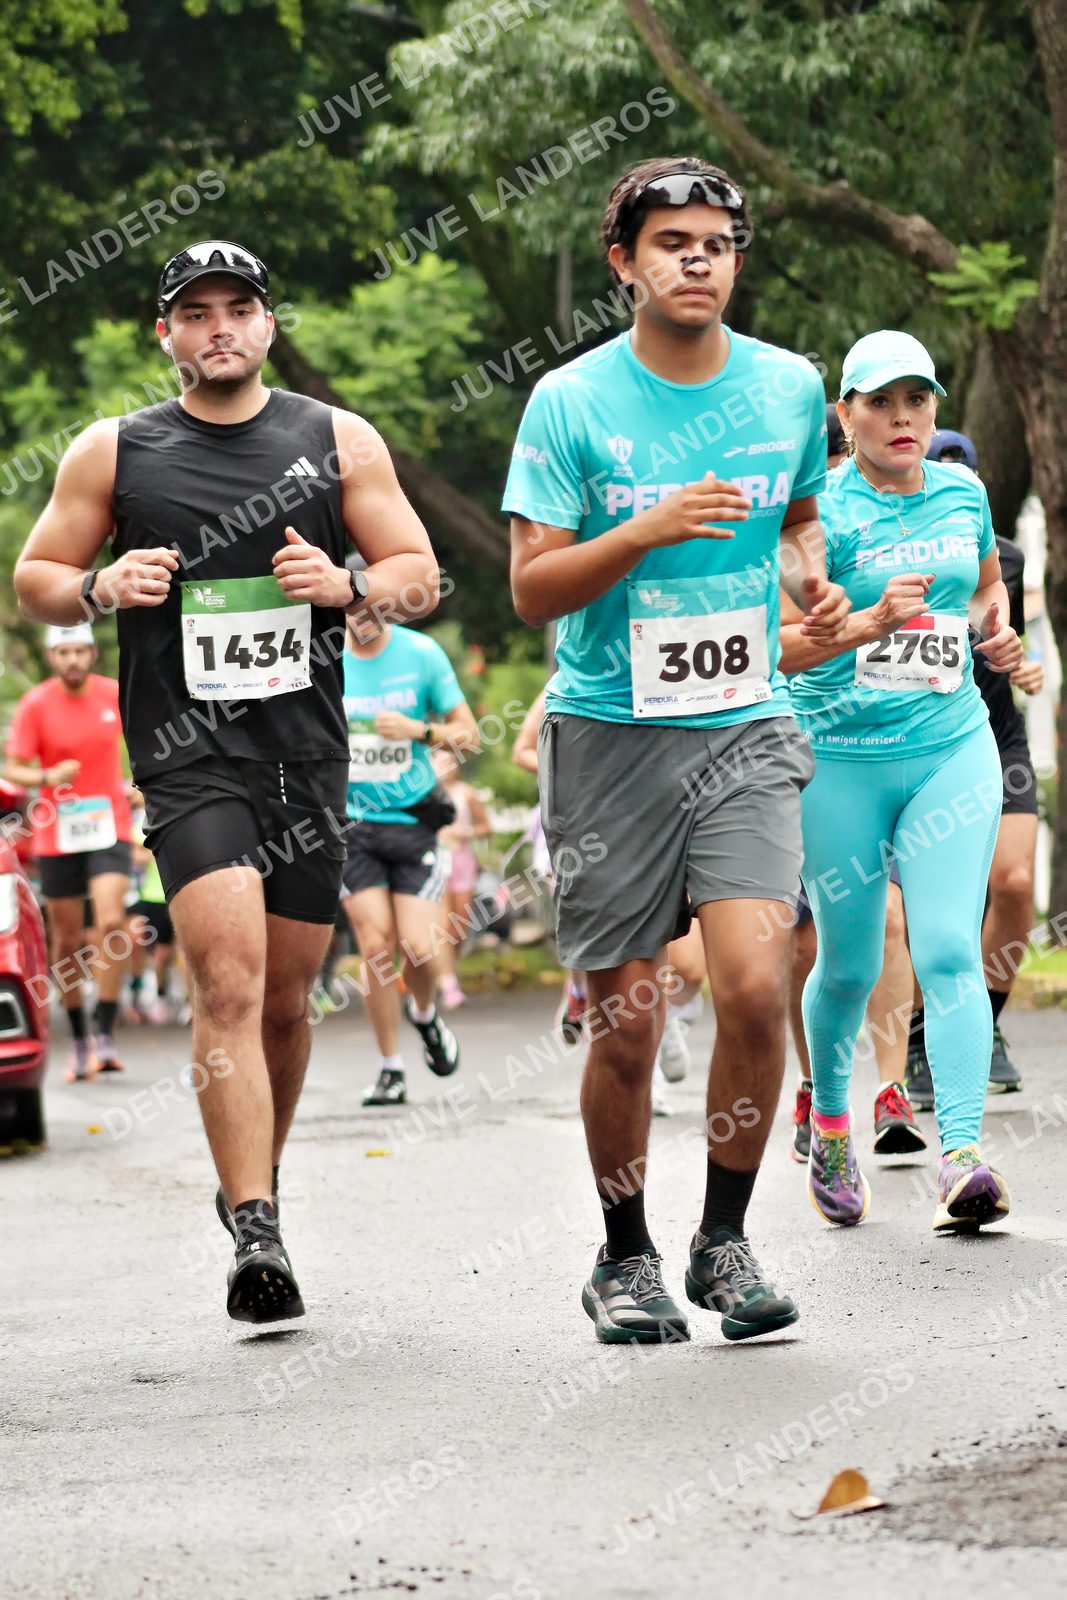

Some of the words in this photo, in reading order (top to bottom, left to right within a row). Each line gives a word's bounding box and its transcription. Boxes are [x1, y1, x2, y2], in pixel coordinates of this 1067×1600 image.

[196, 628, 304, 671] 1434
[658, 634, 750, 683] 308
[866, 633, 960, 668] 2765
[643, 695, 679, 704] PERDURA
[826, 734, 859, 747] amigos
[860, 731, 907, 746] corriendo
